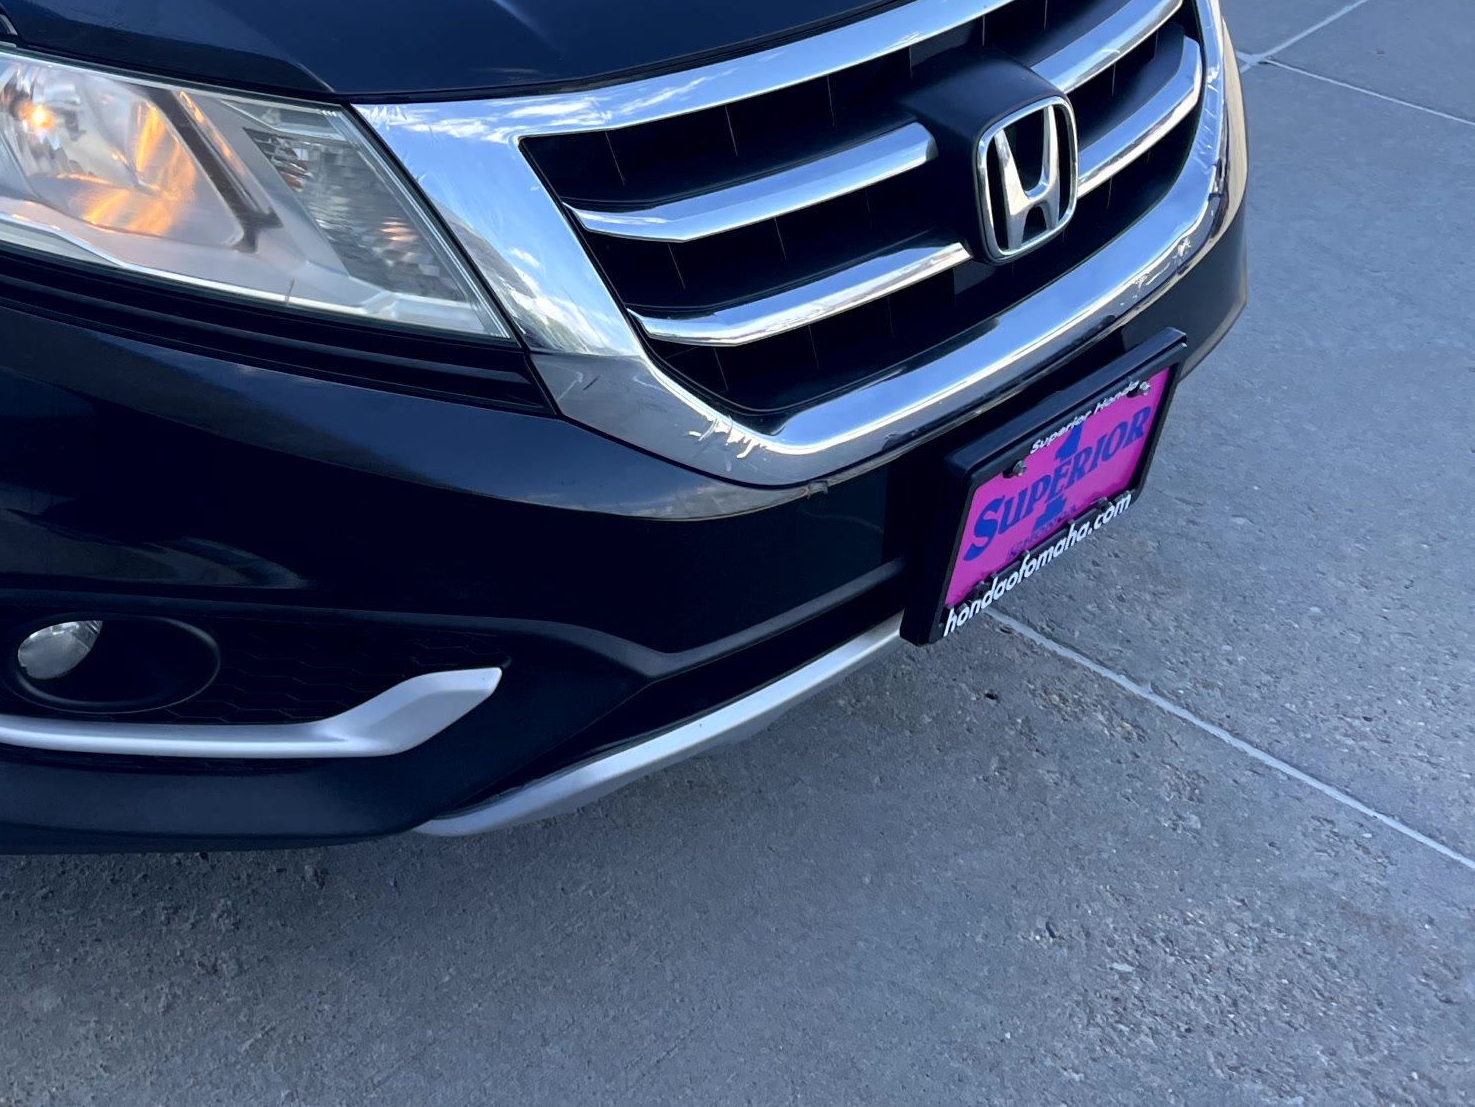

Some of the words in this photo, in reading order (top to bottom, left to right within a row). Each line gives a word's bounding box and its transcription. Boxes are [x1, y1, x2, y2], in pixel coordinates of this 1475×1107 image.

[963, 406, 1152, 562] SUPERIOR
[1030, 410, 1092, 454] Superior
[1093, 380, 1140, 414] Honda
[943, 493, 1132, 637] hondaofomaha.com
